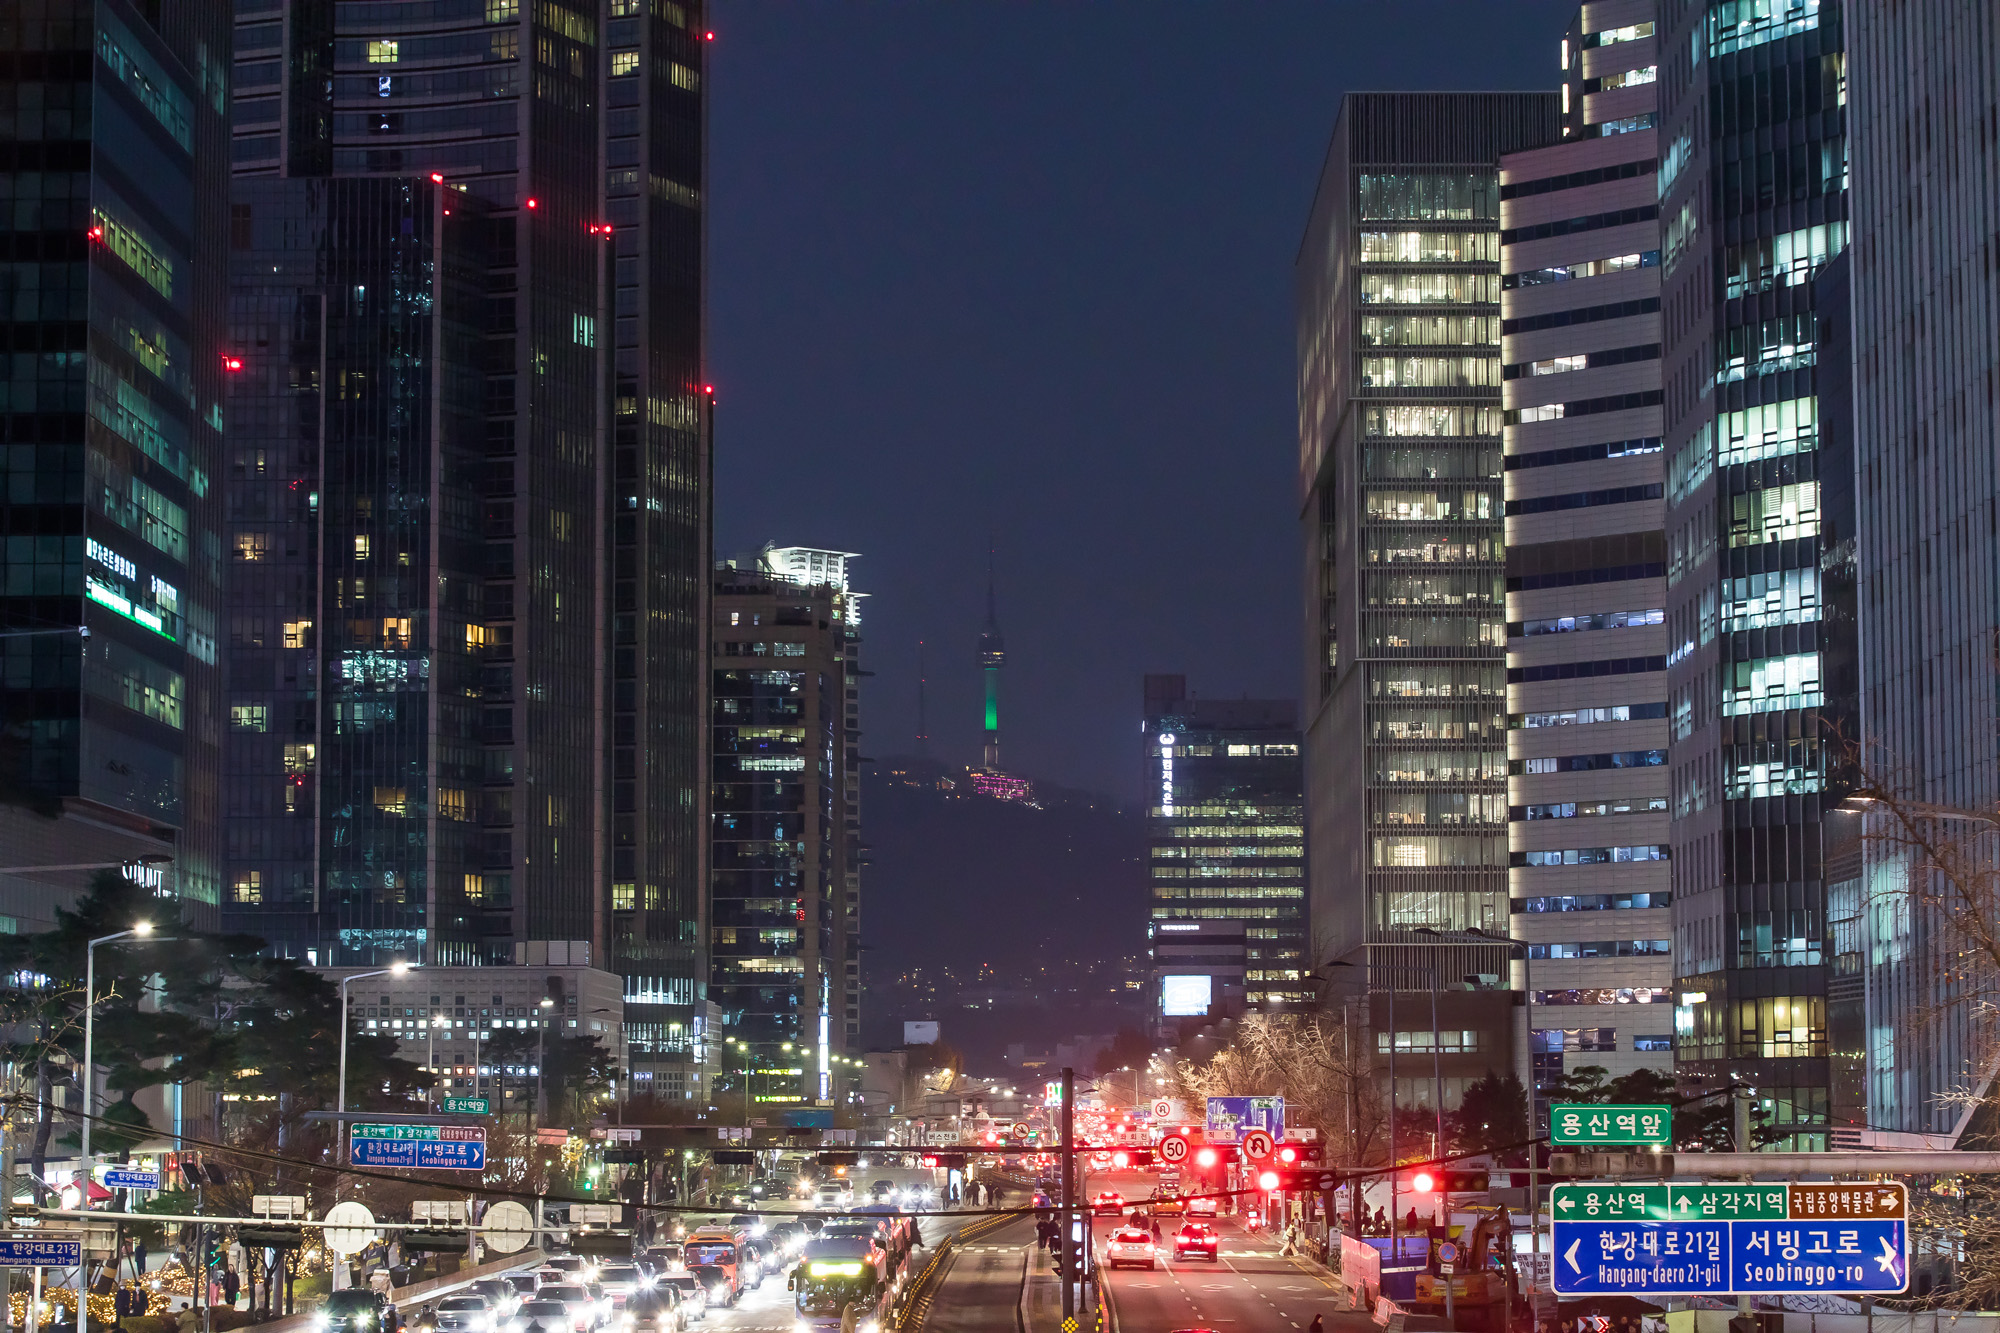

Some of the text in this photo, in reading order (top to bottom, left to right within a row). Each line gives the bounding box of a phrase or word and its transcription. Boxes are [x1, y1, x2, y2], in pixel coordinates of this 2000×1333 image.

[447, 1099, 485, 1112] 용산역앞
[362, 1127, 386, 1137] 용산역
[1561, 1113, 1662, 1136] 용산역앞
[929, 1133, 957, 1141] 버스전용
[368, 1142, 414, 1155] 한강대로21길
[422, 1144, 467, 1157] 서빙고로
[1167, 1142, 1184, 1157] 50
[421, 1156, 468, 1166] Seobinggo-ro
[1583, 1193, 1645, 1215] 용산역
[1699, 1192, 1783, 1215] 삼각지역
[1793, 1191, 1874, 1214] 국립중앙박물관
[12, 1243, 79, 1256] 한강대로21길
[1599, 1230, 1720, 1261] 한강대로21길
[1746, 1230, 1862, 1260] 서빙고로
[0, 1256, 79, 1265] Hangang-daero 21-gil
[1599, 1264, 1721, 1287] Hangang-daero 21-gil
[1745, 1262, 1863, 1286] Seobinggo-ro
